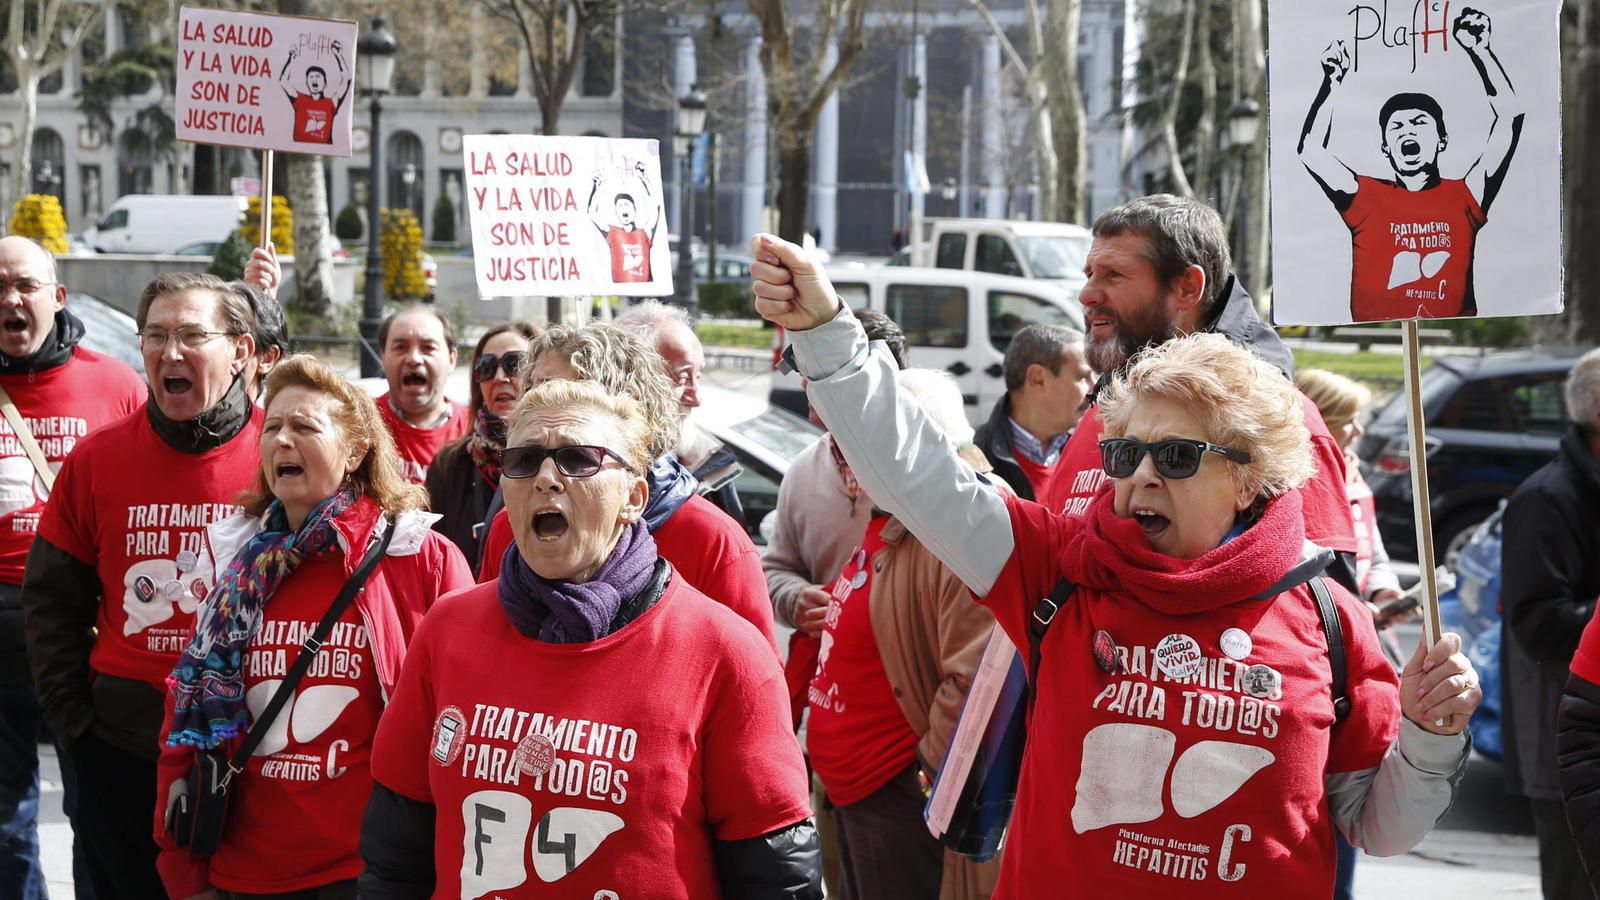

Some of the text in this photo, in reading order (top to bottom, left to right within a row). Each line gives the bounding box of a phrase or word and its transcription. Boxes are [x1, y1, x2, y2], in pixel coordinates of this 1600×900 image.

[183, 20, 273, 48] LA SALUD
[183, 49, 272, 78] Y LA VIDA
[191, 81, 261, 106] SON DE
[183, 108, 265, 136] JUSTICIA
[471, 151, 573, 176] LA SALUD
[473, 187, 578, 211] Y LA VIDA
[490, 222, 570, 246] SON DE
[1390, 221, 1450, 236] TRATAMIENTO
[486, 257, 580, 282] JUSTICIA
[1438, 279, 1447, 300] C
[126, 530, 170, 557] PARA
[297, 648, 363, 679] OD@S
[1092, 680, 1281, 739] PARA TOD@S
[469, 704, 638, 762] TRATAMIENTO
[261, 739, 349, 781] HEPATITIS C
[462, 743, 523, 786] PARA
[1118, 828, 1165, 847] Plataforma
[1112, 823, 1252, 882] HEPATITIS C
